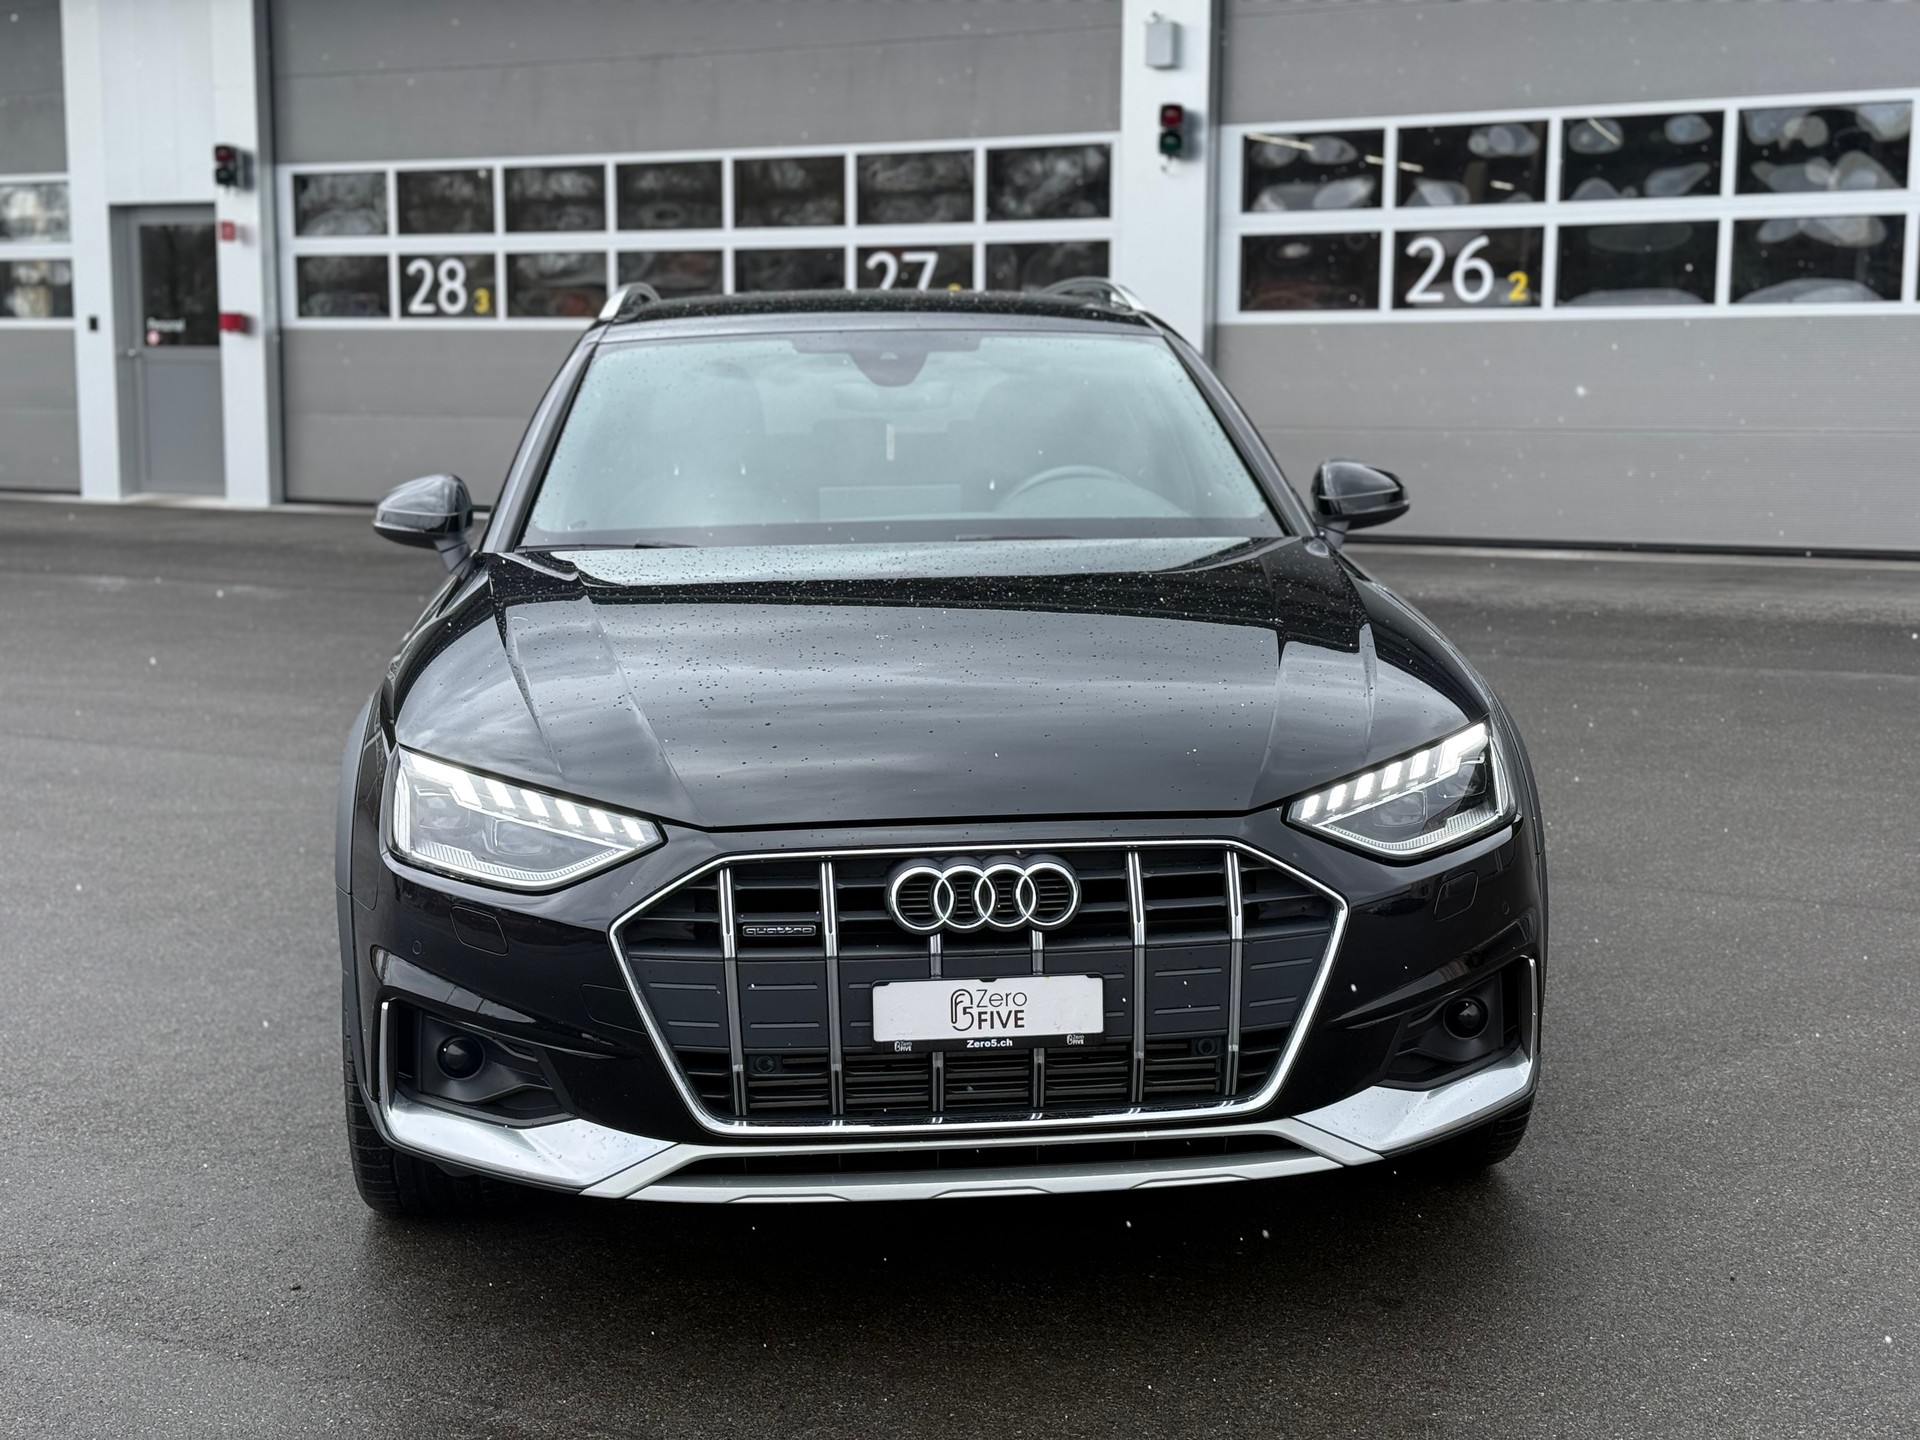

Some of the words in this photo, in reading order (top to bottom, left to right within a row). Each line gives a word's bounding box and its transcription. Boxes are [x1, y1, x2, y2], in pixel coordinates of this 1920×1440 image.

[866, 251, 939, 290] 27
[1405, 235, 1494, 303] 26
[1507, 271, 1528, 302] 2
[406, 258, 468, 315] 28
[473, 287, 490, 314] 3
[746, 926, 813, 935] quattro
[976, 989, 1028, 1008] Zero
[977, 1009, 1025, 1030] FIVE
[966, 1038, 1013, 1048] Zero5.ch
